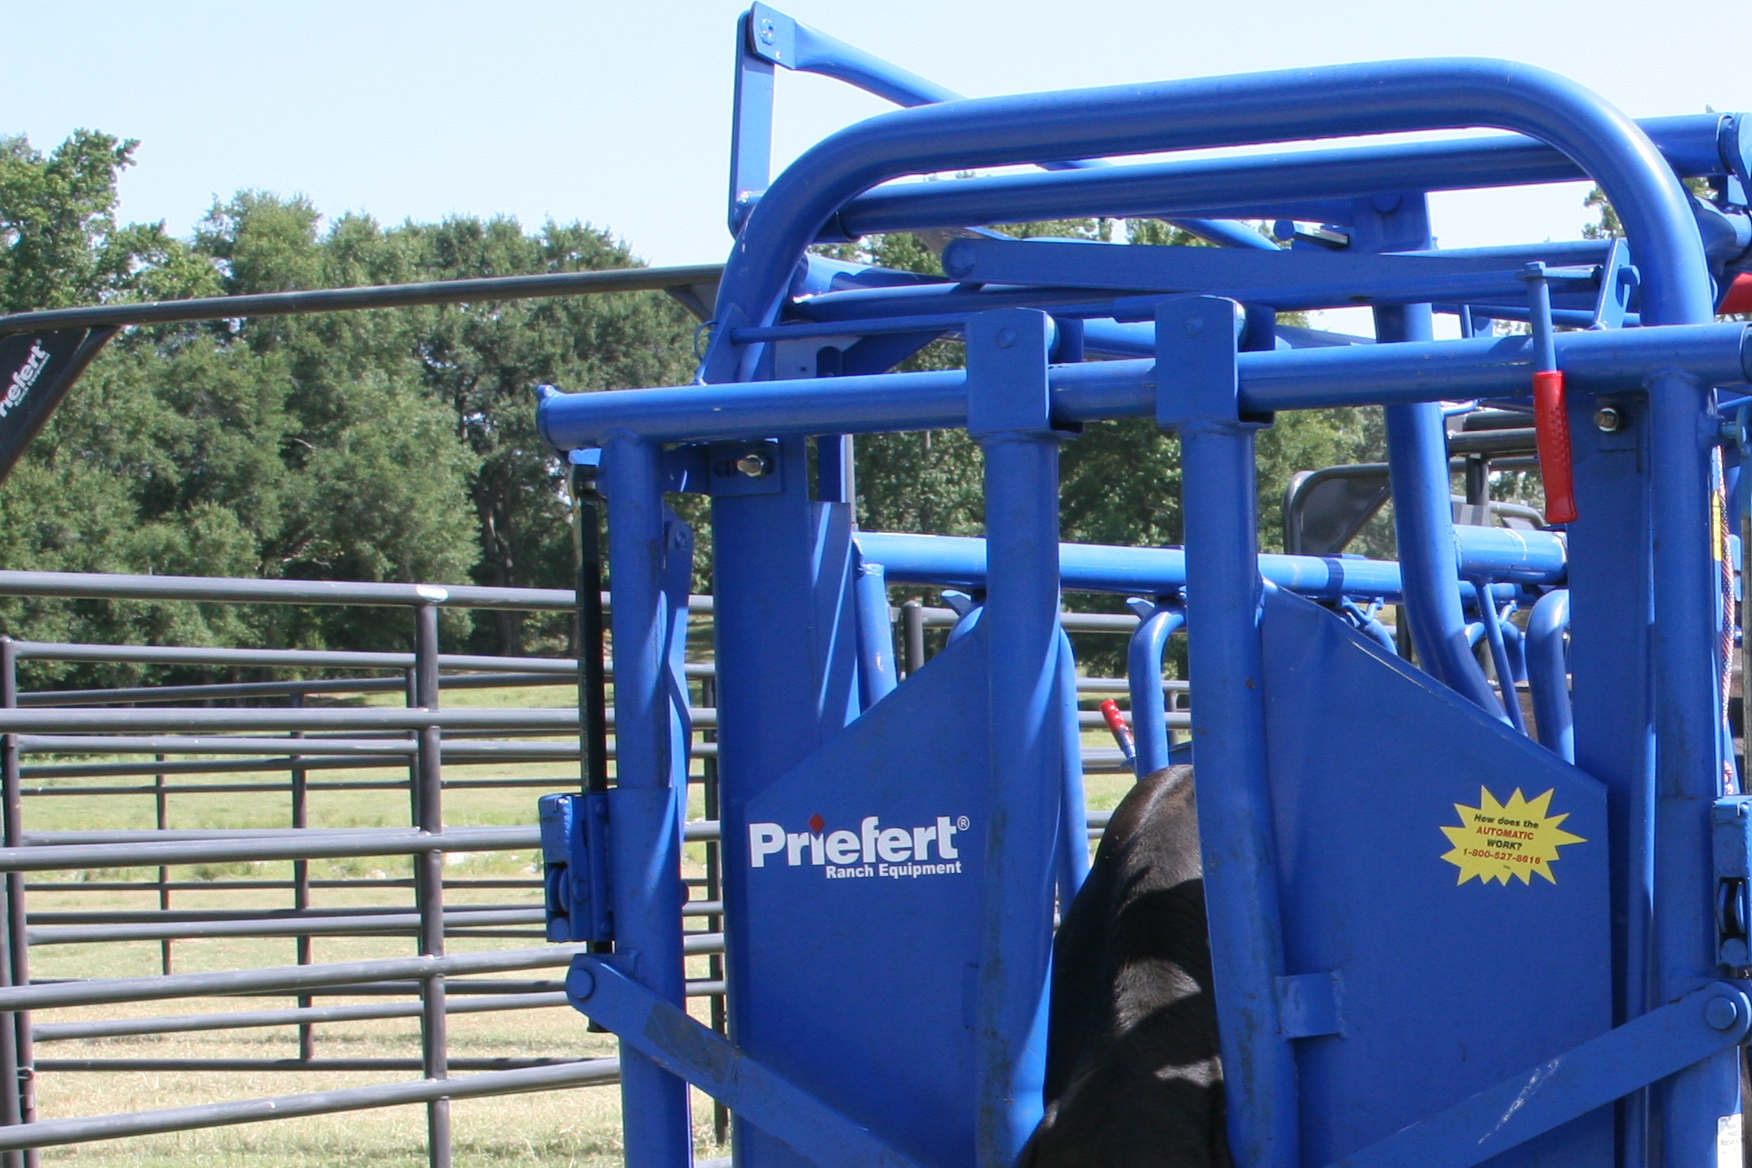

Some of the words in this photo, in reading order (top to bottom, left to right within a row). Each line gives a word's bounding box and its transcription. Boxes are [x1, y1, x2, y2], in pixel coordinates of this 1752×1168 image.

[0, 345, 46, 417] riefert
[1474, 813, 1495, 824] How
[1498, 816, 1521, 827] does
[1523, 820, 1539, 829] the
[1476, 826, 1535, 841] AUTOMATIC
[1486, 838, 1523, 850] WORK?
[826, 864, 874, 879] Ranch
[878, 861, 962, 880] Equipment
